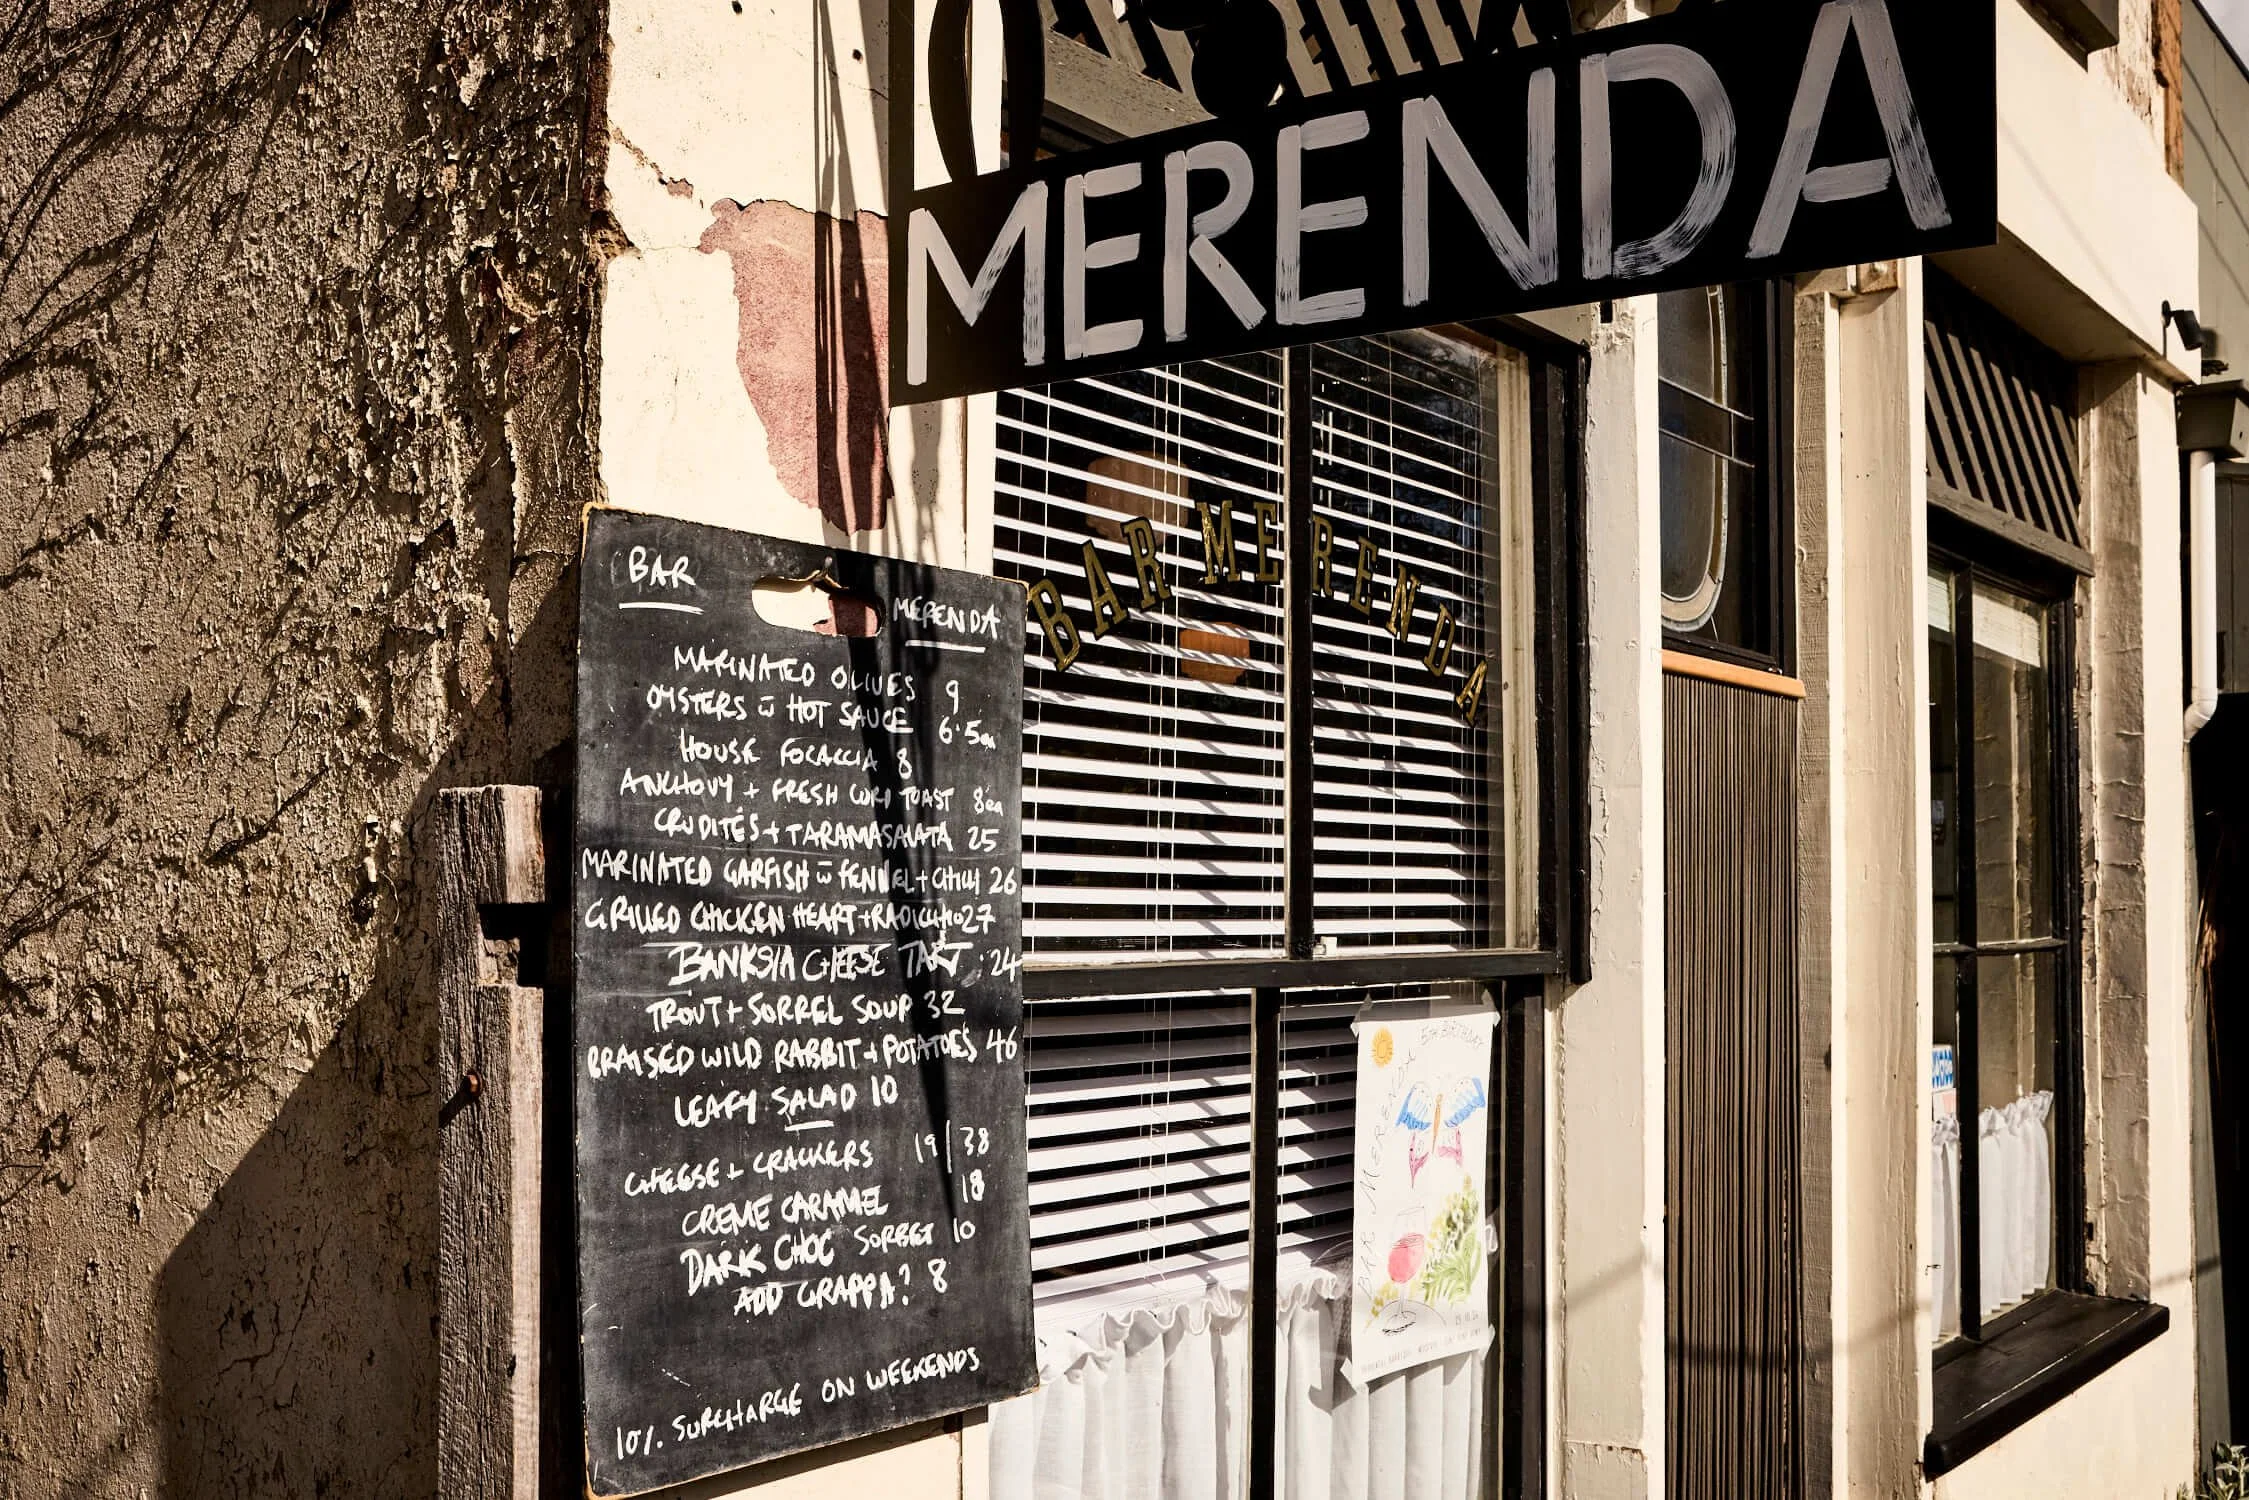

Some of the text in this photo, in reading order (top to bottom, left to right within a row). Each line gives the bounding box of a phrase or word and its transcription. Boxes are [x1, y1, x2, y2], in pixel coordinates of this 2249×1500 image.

[905, 0, 1953, 387] MERENDA
[628, 545, 697, 588] BAR
[893, 596, 1000, 640] MERENDA
[1027, 499, 1489, 728] BAR MERENDA
[674, 646, 959, 715] MARINATED OLIVES 9
[647, 684, 748, 721] OYSTERS
[787, 696, 832, 729] HOT
[839, 702, 914, 733] SAUCE
[680, 728, 912, 779] HOUSE FOCACCIA 8
[620, 767, 733, 803] ANCHOVY
[772, 778, 838, 806] FRESH
[899, 786, 954, 811] TOAST
[785, 820, 953, 851] TARAMASALATA
[967, 826, 1000, 851] 25
[582, 848, 712, 887] MARINATED
[724, 862, 809, 894] GARFISH
[838, 858, 915, 894] FENNEL
[989, 866, 1017, 895] 26
[584, 895, 681, 934] GRILLED
[690, 900, 785, 937] CHICKEN
[793, 902, 857, 937] HEART
[961, 904, 996, 935] 27
[650, 940, 1023, 986] BANKSIA CHEESE TART 24
[645, 996, 723, 1033] TROUT
[752, 992, 843, 1027] SORREL
[852, 994, 914, 1023] SOUP
[925, 990, 965, 1019] 32
[587, 1043, 693, 1080] BRAISED
[701, 1038, 762, 1073] WILD
[774, 1037, 861, 1074] RABBIT
[986, 1026, 1018, 1064] 46
[674, 1074, 899, 1128] LEAFY SALAD 10
[624, 1157, 720, 1197] CHEESE
[752, 1139, 874, 1180] CRACKERS
[682, 1168, 985, 1237] CREME CARAMEL 18
[680, 1217, 976, 1297] DARK CHOC SORBET 10
[733, 1257, 949, 1317] ADD GRAPPA? 8
[672, 1382, 802, 1441] SURCHARGE
[822, 1375, 855, 1403] ON
[865, 1346, 981, 1392] WEEKENDS
